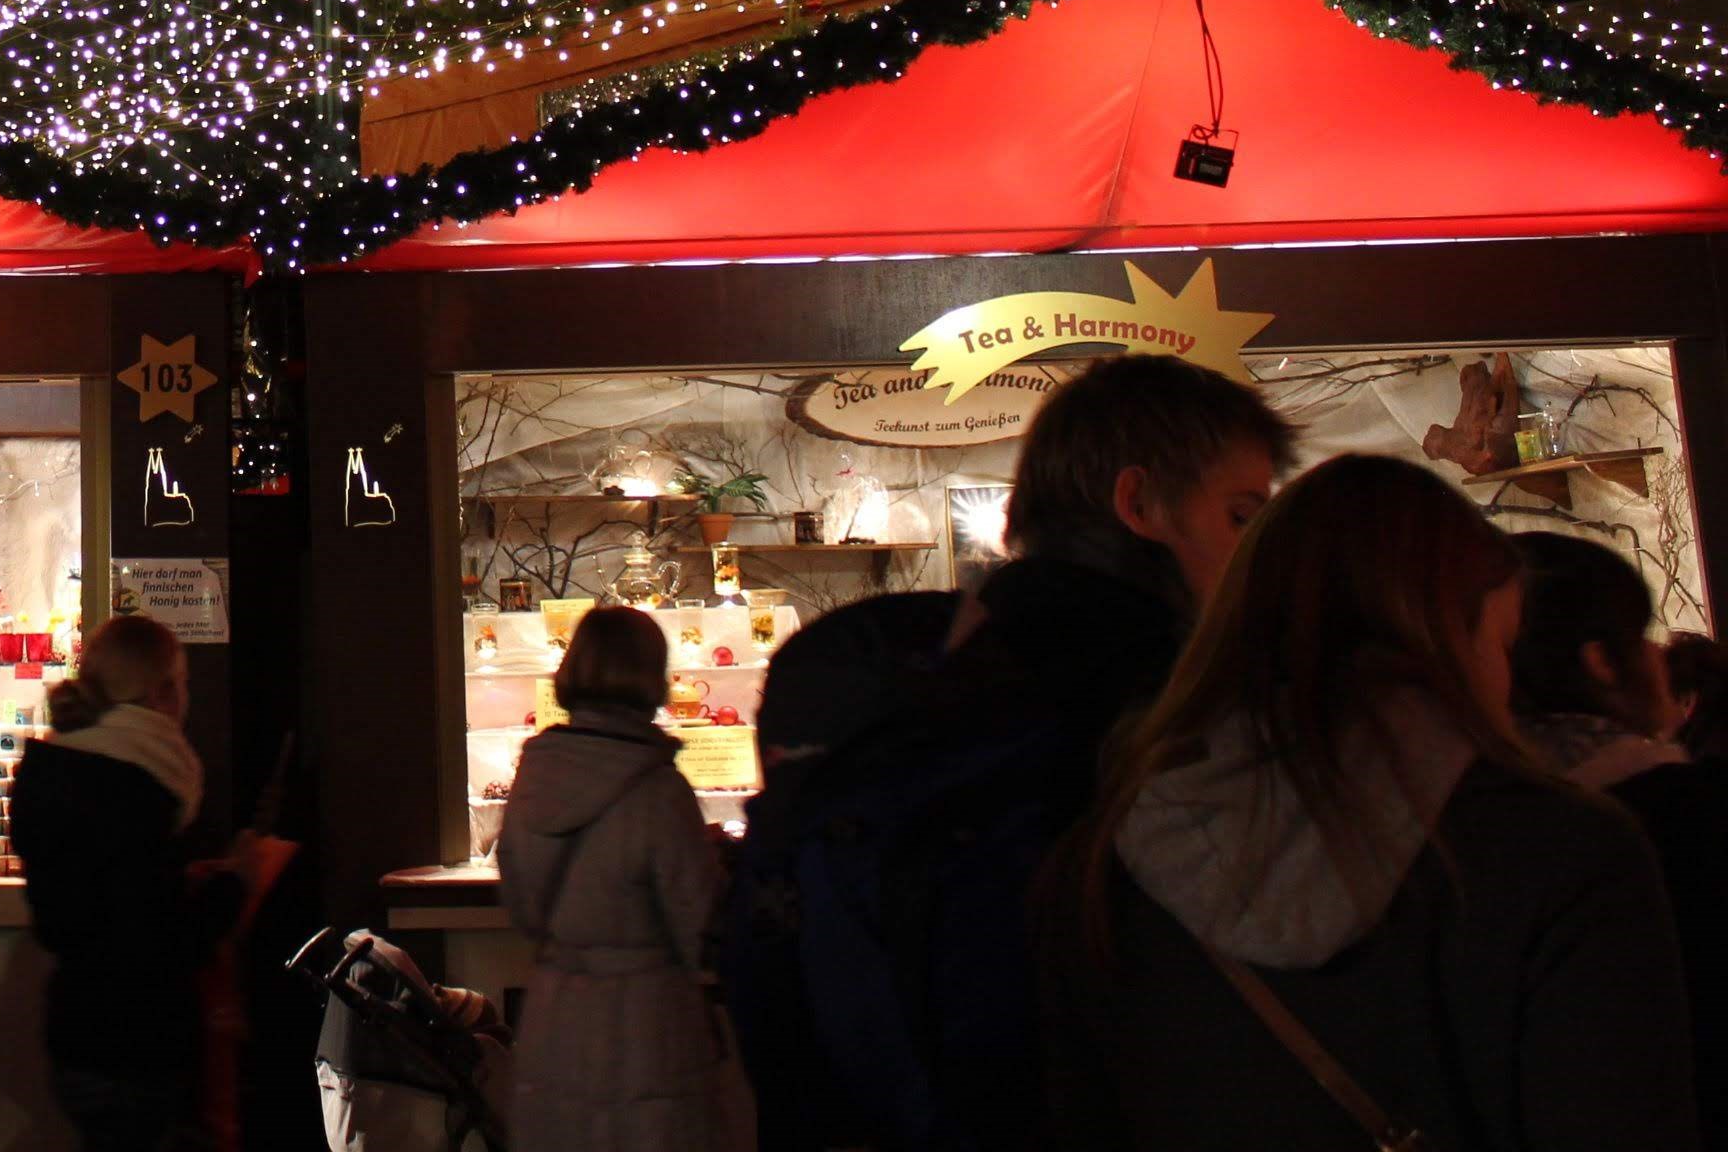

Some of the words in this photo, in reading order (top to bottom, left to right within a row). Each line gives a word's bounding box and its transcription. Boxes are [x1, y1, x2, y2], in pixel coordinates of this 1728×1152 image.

[958, 326, 1014, 354] Tea
[1022, 315, 1045, 341] &
[1053, 312, 1197, 355] Harmony
[140, 362, 193, 394] 103
[833, 381, 877, 410] Tea
[883, 369, 929, 395] and
[874, 419, 930, 433] Teekunst
[935, 420, 961, 432] zum
[964, 412, 1021, 433] Genießen
[131, 567, 154, 579] Hier
[155, 567, 178, 581] darf
[179, 569, 203, 579] man
[142, 580, 194, 593] finnischen
[149, 594, 180, 608] Honig
